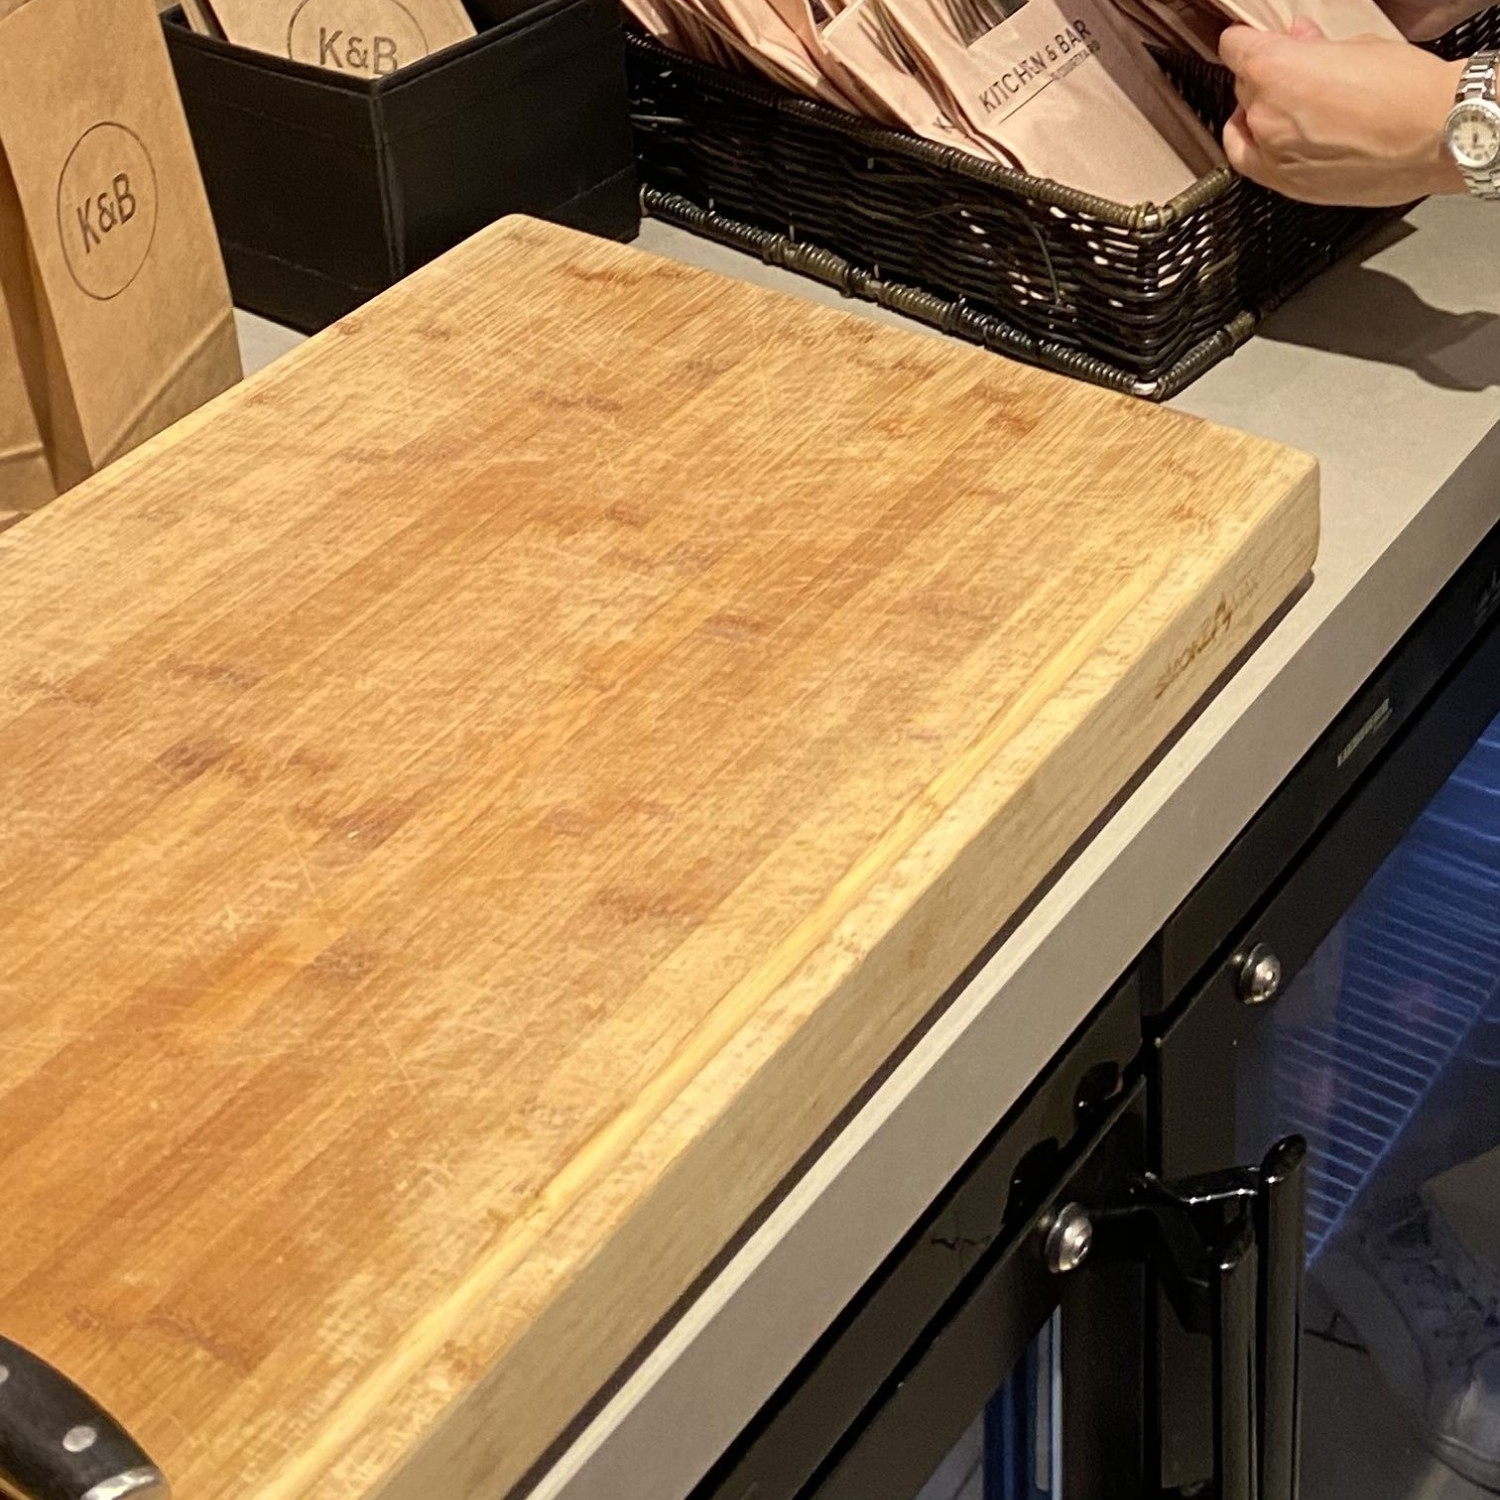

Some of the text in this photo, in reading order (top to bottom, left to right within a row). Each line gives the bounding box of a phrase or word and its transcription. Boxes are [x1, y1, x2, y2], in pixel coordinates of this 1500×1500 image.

[319, 26, 399, 76] K&B
[978, 19, 1093, 116] KITCHEN & BAR
[76, 171, 137, 255] K&B
